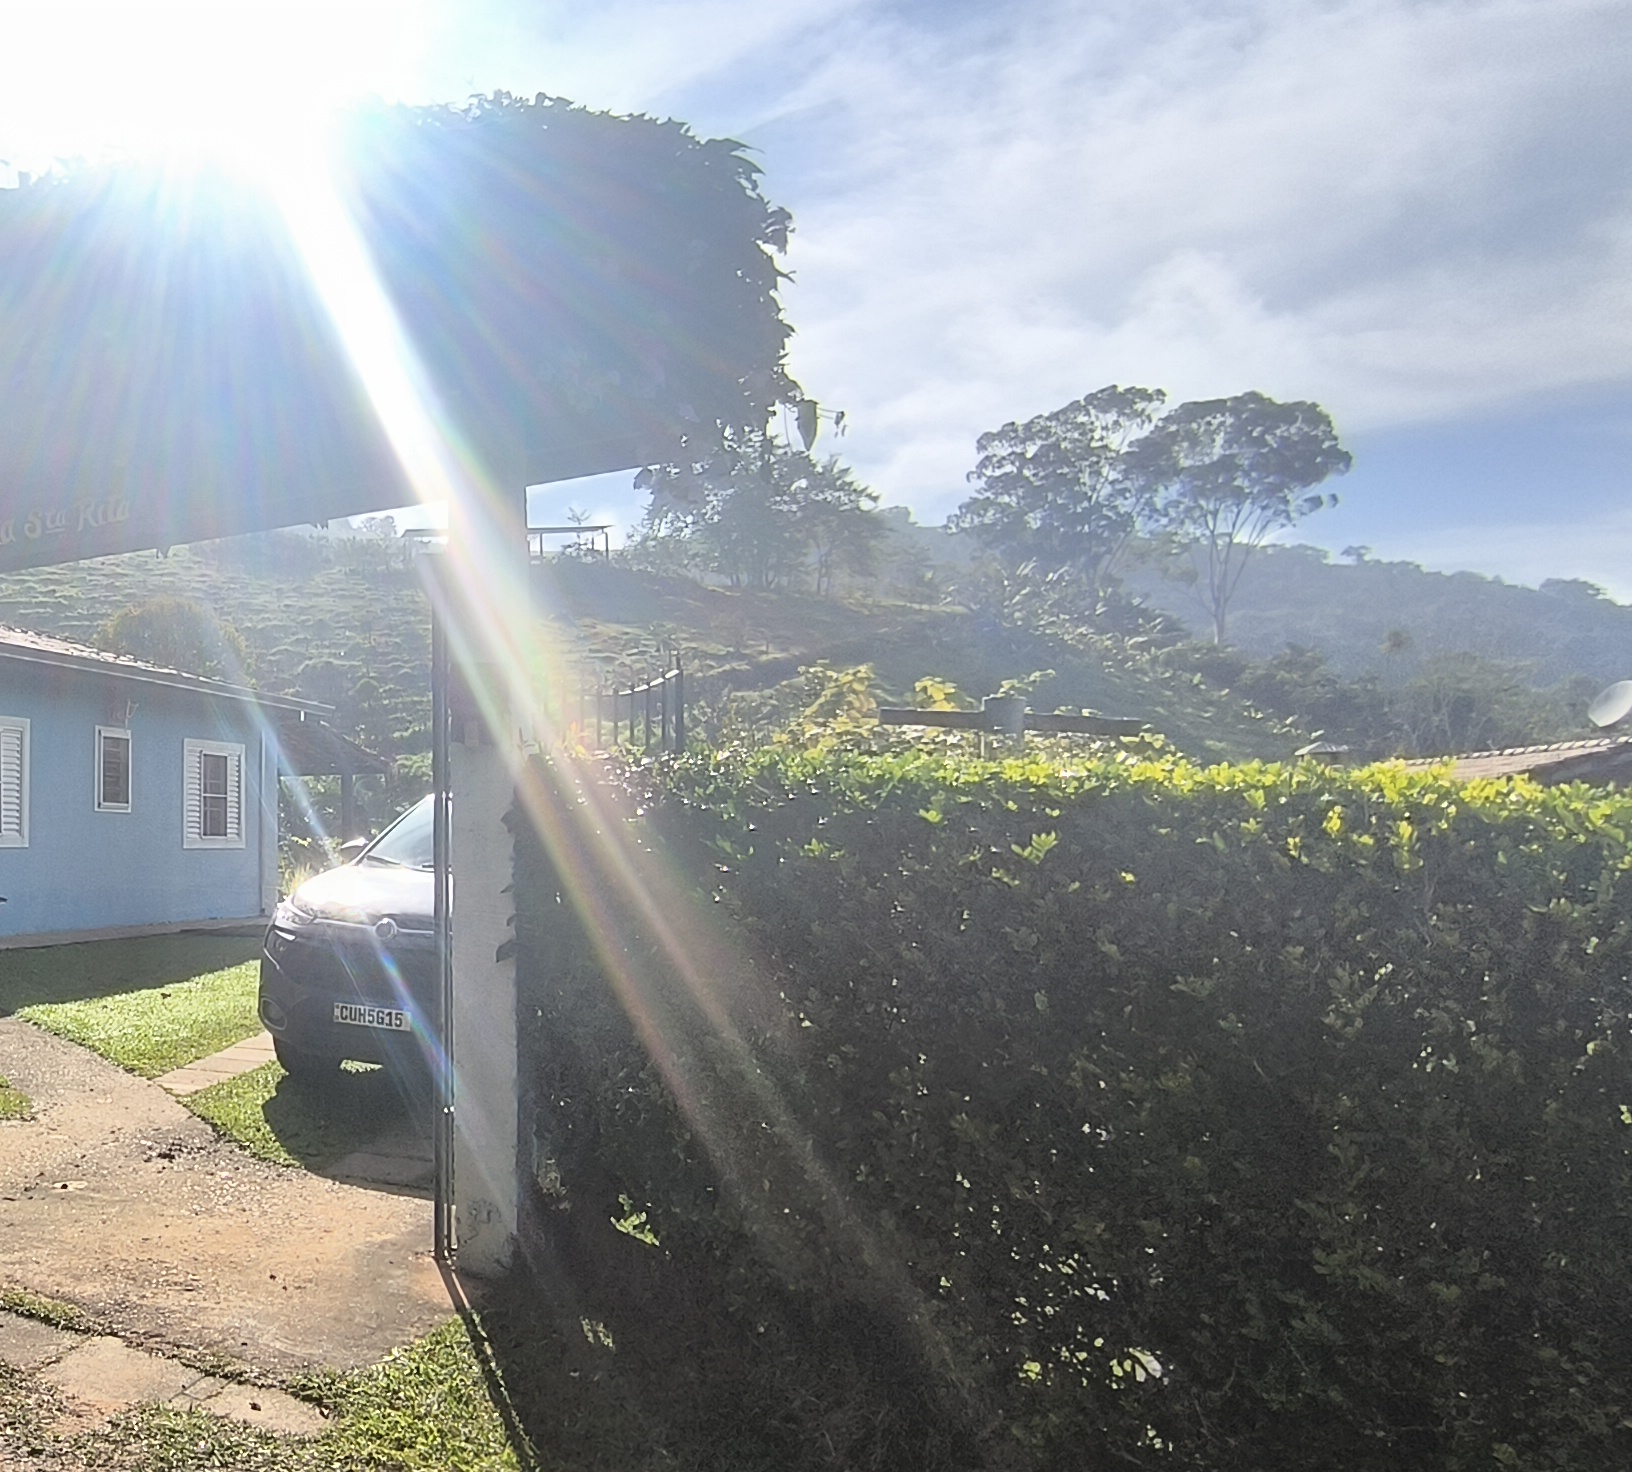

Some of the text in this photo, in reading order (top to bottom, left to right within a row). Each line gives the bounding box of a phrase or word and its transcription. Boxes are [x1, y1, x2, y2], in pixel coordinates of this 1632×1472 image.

[24, 507, 67, 539] Sta
[75, 496, 131, 532] Rita
[340, 1005, 404, 1028] CUH5G15
